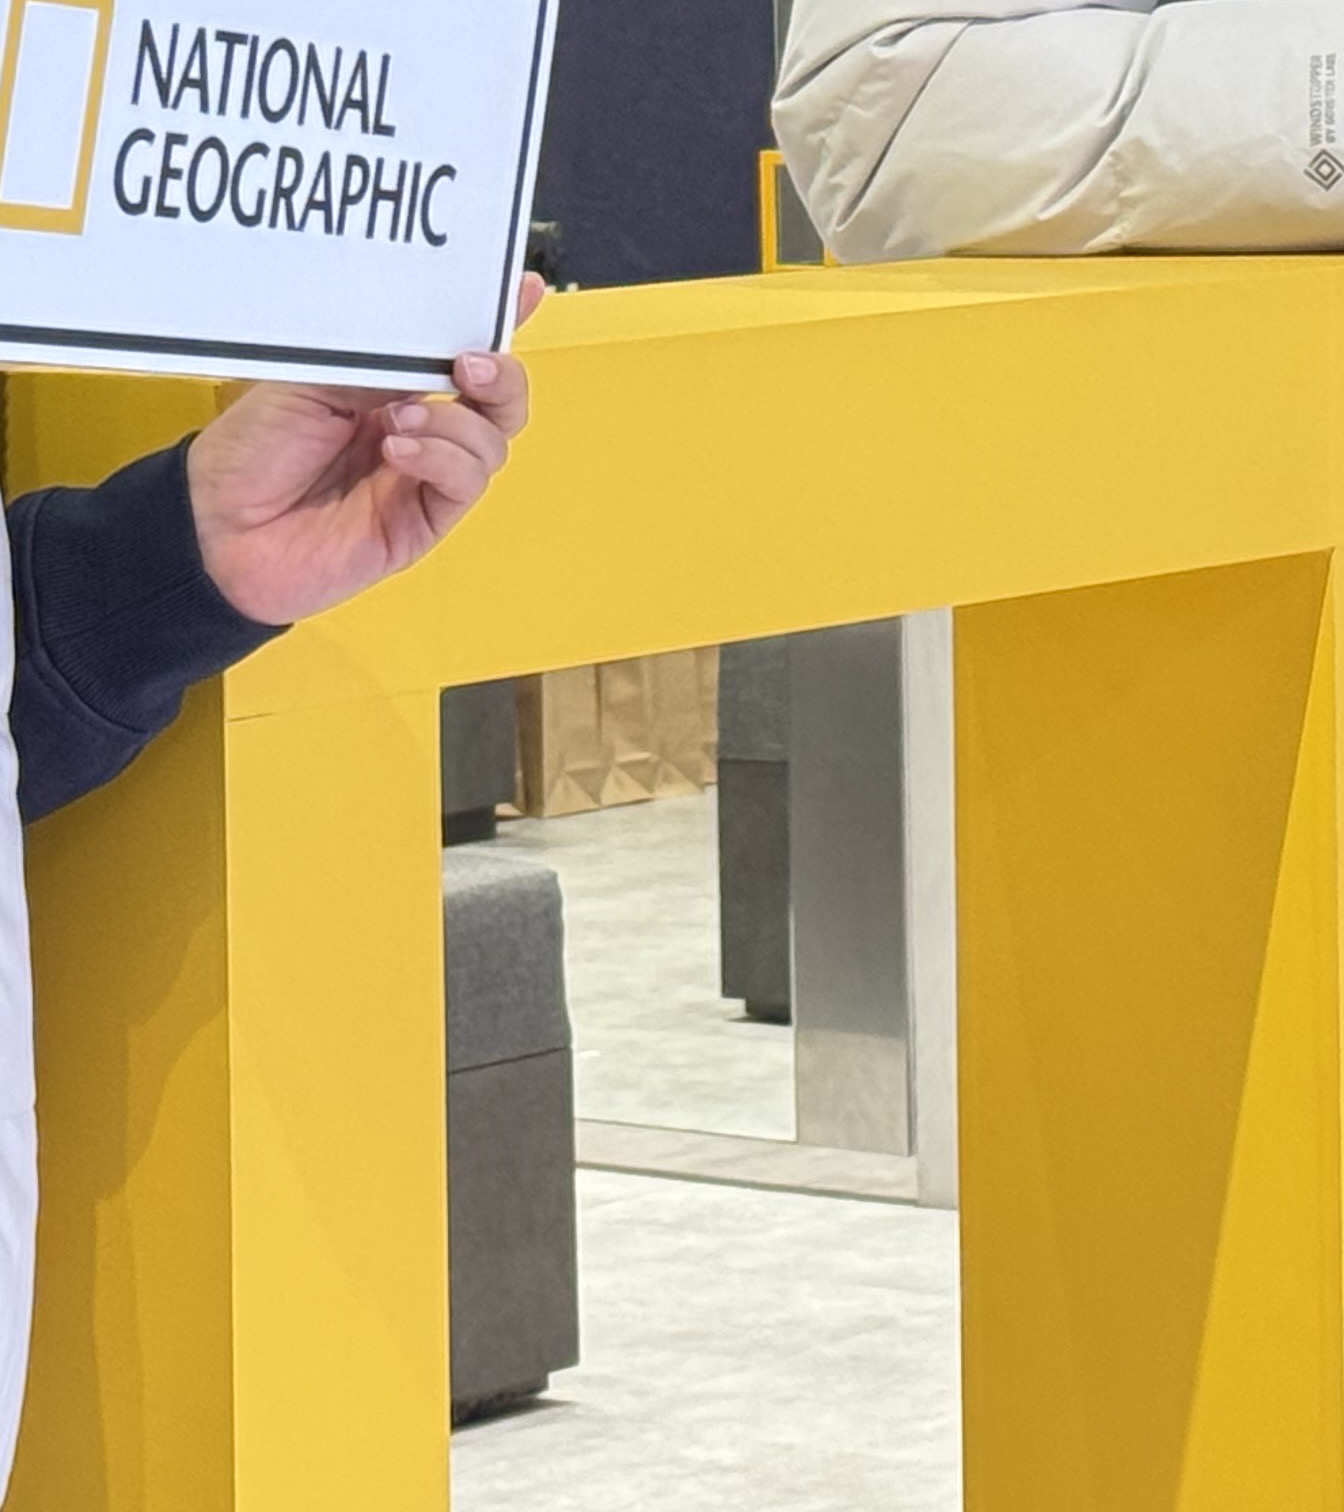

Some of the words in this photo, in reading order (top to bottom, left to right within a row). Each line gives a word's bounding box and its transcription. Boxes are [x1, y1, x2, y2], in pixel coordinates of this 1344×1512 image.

[130, 18, 396, 138] NATIONAL
[1309, 54, 1323, 147] WINDSTOPPER
[113, 128, 458, 248] GEOGRAPHIC
